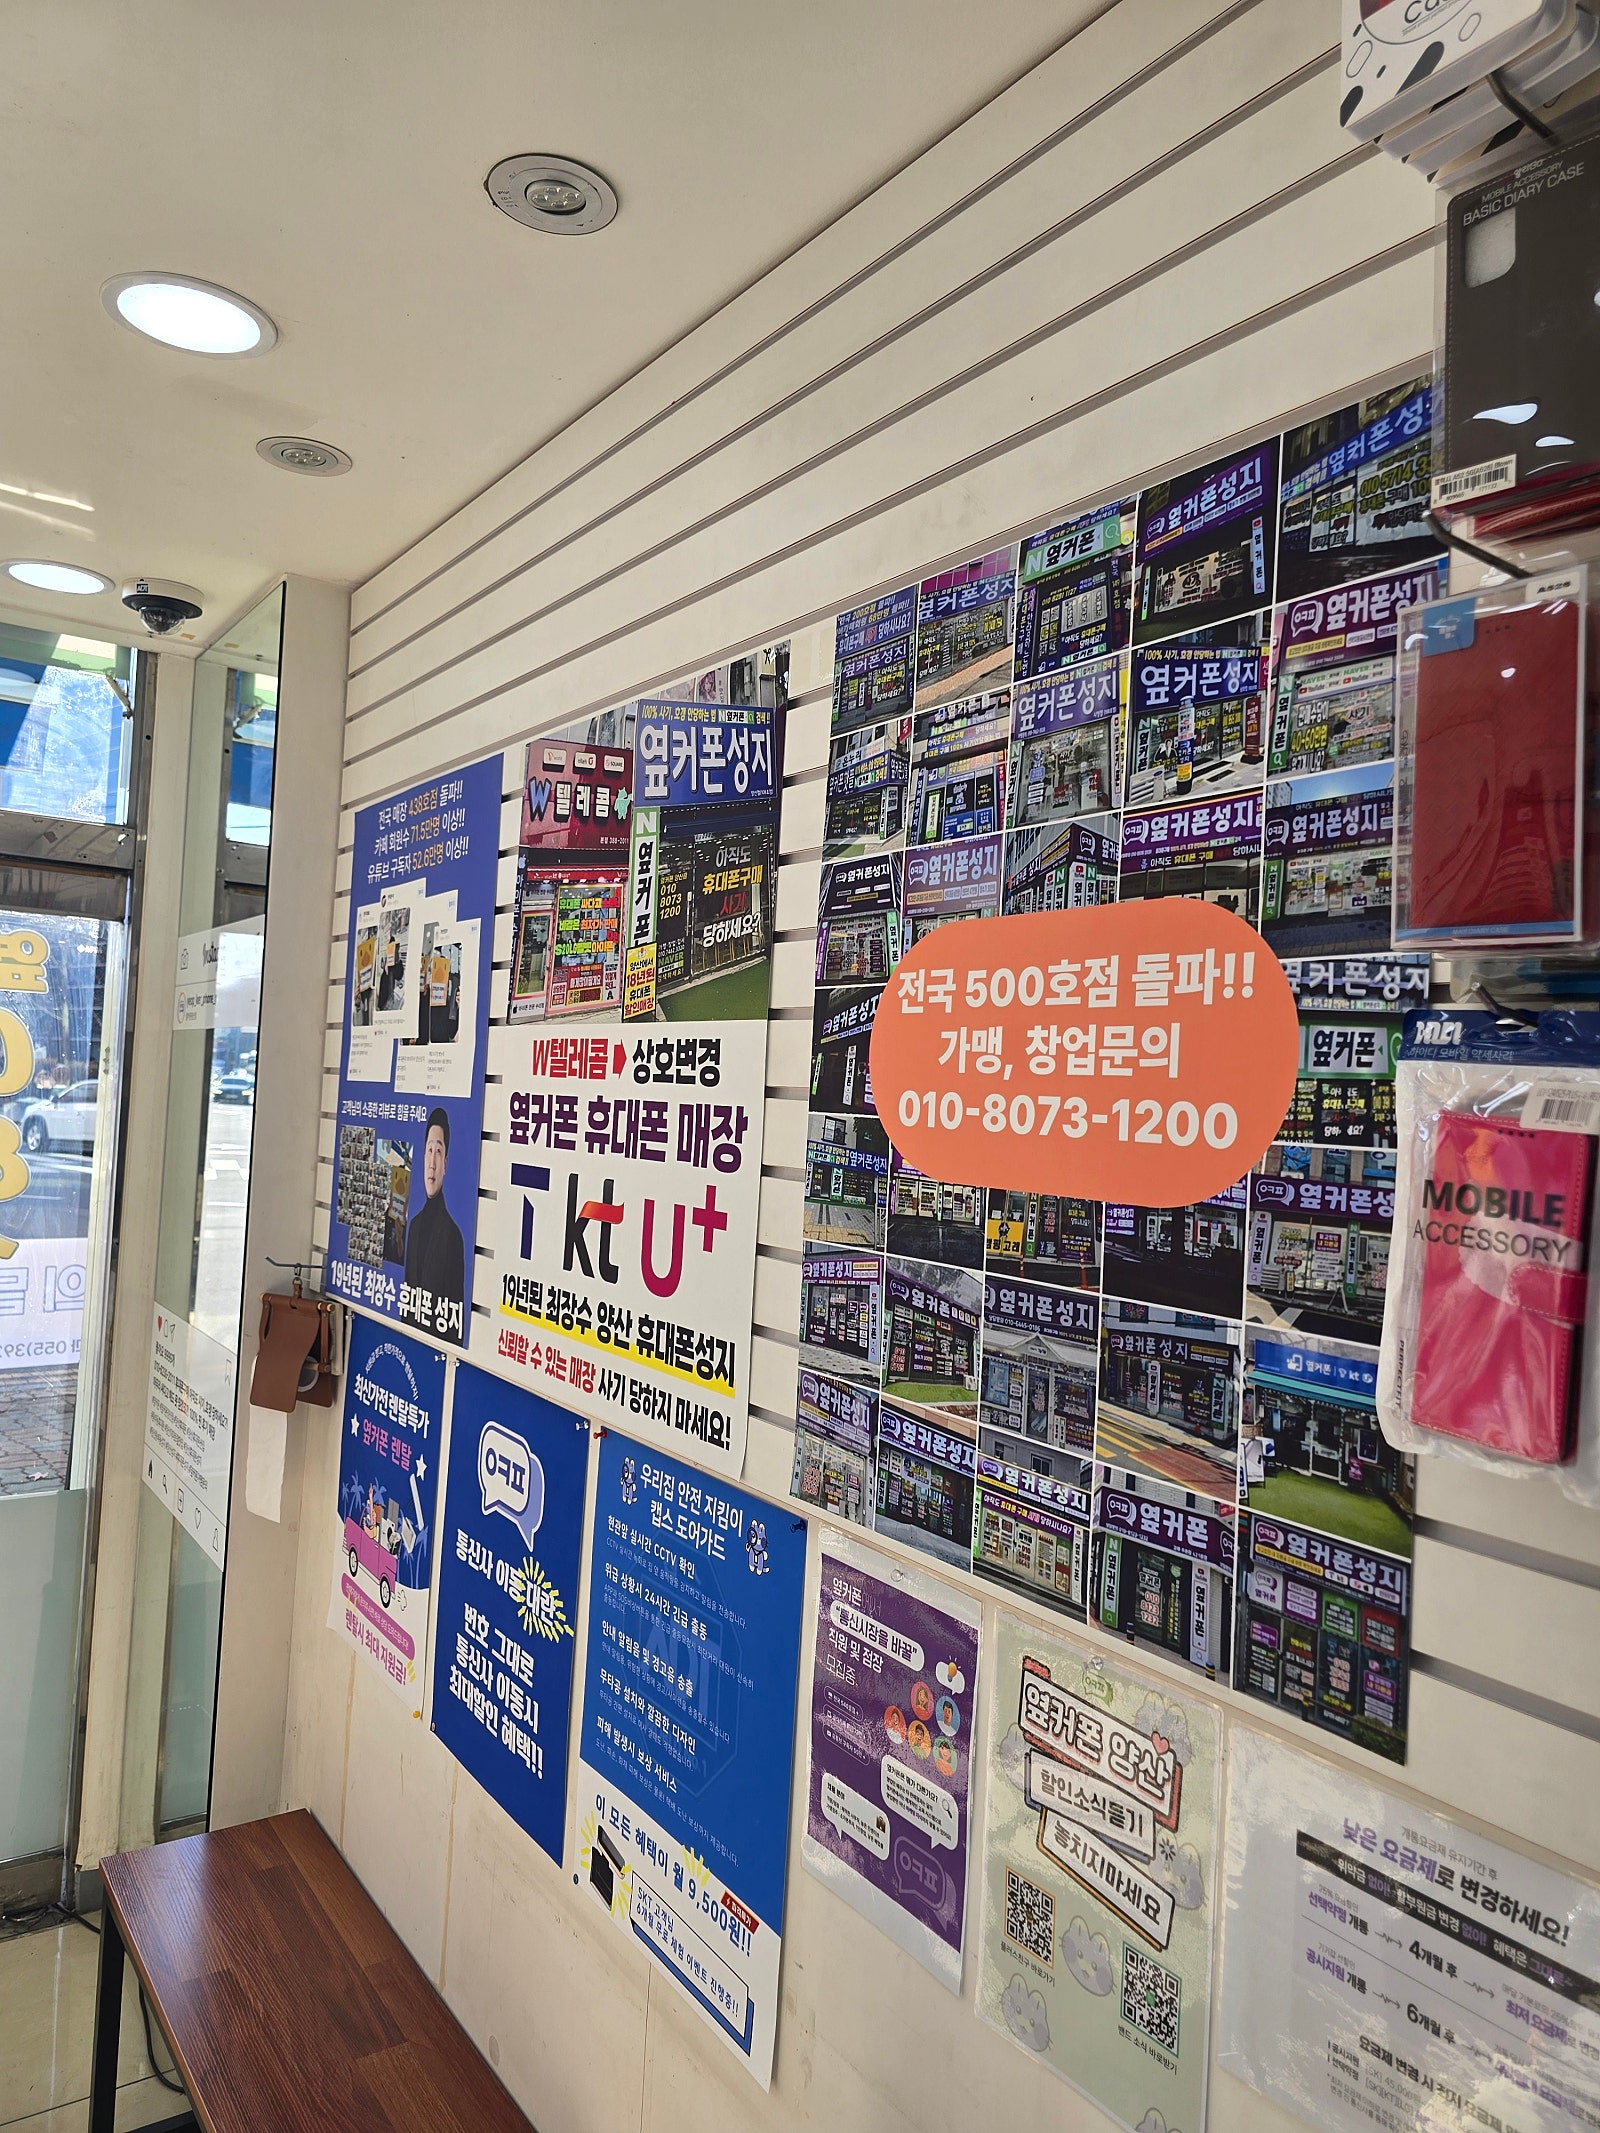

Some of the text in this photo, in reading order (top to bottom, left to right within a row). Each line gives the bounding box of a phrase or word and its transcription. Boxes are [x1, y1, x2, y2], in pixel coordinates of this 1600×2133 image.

[1464, 162, 1584, 227] BASIC DIARY CASE
[1168, 457, 1262, 531] 옆커폰성지
[844, 642, 907, 678] 옆커폰성지
[1140, 656, 1259, 707] 옆커폰성지
[1018, 670, 1118, 732] 옆커폰성지
[636, 723, 773, 803] 옆커폰성지
[379, 780, 462, 829] 전국 매장 438호점 돌파!!
[528, 776, 610, 821] W텔레콤
[1150, 799, 1253, 843] 옆커폰성지
[374, 808, 464, 855] 카페 회원수 71.5만명 이상!!
[1292, 811, 1378, 844] 옆커폰성지
[368, 836, 468, 883] 유튜브 구독자 52.6만명 이상!!
[703, 865, 763, 895] 휴대폰구매
[716, 849, 751, 868] 아직도
[848, 863, 890, 883] 옆커폰성지
[928, 844, 998, 886] 옆커폰성지
[660, 894, 682, 907] 8073
[660, 906, 680, 919] 1200
[661, 883, 676, 895] 010
[703, 912, 760, 948] 당하세요?
[627, 968, 654, 988] 18년된
[630, 958, 653, 971] 양산에서
[658, 952, 684, 967] NAVER
[898, 949, 1255, 1013] 전국 500호점 돌파!!
[625, 998, 654, 1016] 할인매장
[630, 985, 650, 1001] 휴대폰
[533, 1038, 719, 1086] W텔레콤 상호변경
[938, 1022, 1181, 1081] 가맹, 창업문의
[1312, 1029, 1375, 1068] 옆커폰
[1409, 1047, 1438, 1058] 하이디
[1438, 1048, 1468, 1060] 모바일
[510, 1092, 747, 1172] 옆커폰 휴대폰 매장
[899, 1090, 1238, 1150] 010-8073-1200
[1422, 1179, 1564, 1227] MOBILE
[511, 1163, 726, 1296] T kt U+
[1413, 1220, 1572, 1263] ACCESSORY
[332, 1261, 462, 1338] 19년된 최장수 휴대폰 성지
[1000, 1288, 1094, 1330] 옆커폰성지
[500, 1269, 544, 1321] 19년된
[545, 1282, 593, 1339] 최장수
[595, 1298, 632, 1351] 양산
[636, 1310, 736, 1390] 휴대폰성지
[1125, 1335, 1188, 1360] 옆커폰성지
[498, 1329, 730, 1449] 신뢰할 수 있는 매장 사기 당하지 마세요!
[818, 1385, 870, 1432] 옆커폰성지
[363, 1419, 411, 1470] 옆커폰 렌탈
[902, 1420, 978, 1469] 옆커폰성지
[640, 1464, 742, 1536] 우리집 안전 지킴이
[1005, 1467, 1087, 1511] 옆커폰성지
[608, 1515, 694, 1578] 현관앞 실시간 CCTV 확인
[651, 1500, 724, 1559] 캡스 도어가드
[1140, 1502, 1209, 1550] 옆커폰
[456, 1529, 557, 1631] 통신사 이동 대란
[1287, 1532, 1401, 1591] 옆커폰성지
[605, 1563, 706, 1640] 위급 상황시 24시간 긴급 출동
[346, 1608, 363, 1644] 렌탈시
[365, 1629, 378, 1660] 최대
[381, 1645, 405, 1684] 지원금!
[465, 1603, 488, 1647] 번호
[492, 1629, 533, 1686] 그대로
[602, 1620, 692, 1697] 안내 알림음 및 경고음 송출
[828, 1626, 883, 1676] 직원 및 점장
[456, 1633, 537, 1732] 통신사 이동시
[450, 1665, 541, 1777] 최대할인 혜택!!
[600, 1668, 694, 1754] 무타공 설치와 깔끔한 디자인
[597, 1716, 676, 1792] 피해 발생시 보상 서비스
[1024, 1679, 1171, 1806] 옆커폰 양산
[1042, 1773, 1142, 1836] 할인소식듣기
[596, 1794, 753, 1960] 이 모든 혜택이 월 9,500원!!
[1052, 1822, 1161, 1923] 놓치지마세요
[1343, 1816, 1570, 1949] 낮은 요금제로 변경하세요!
[638, 1886, 673, 1932] SKT 고객님
[1306, 1946, 1456, 2048] 공시지원 개통 6개월 후
[1117, 2023, 1177, 2076] 밴드 소식 바로받기
